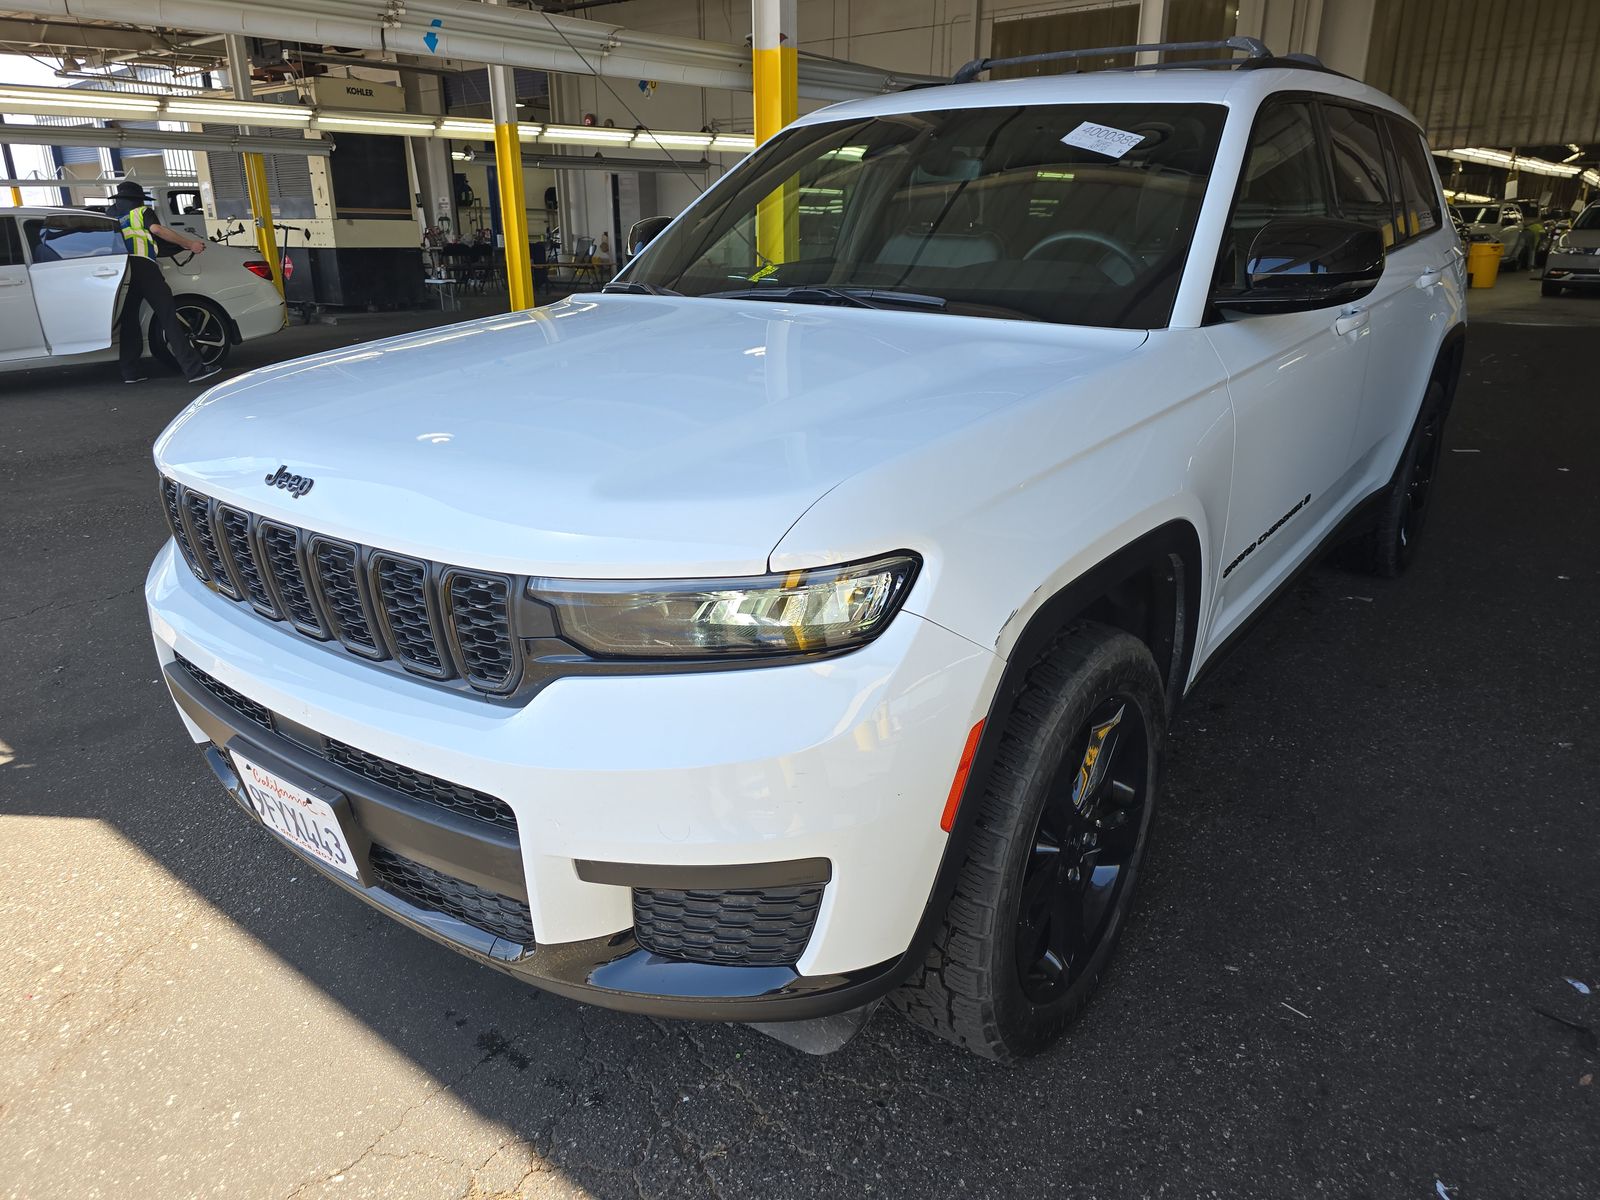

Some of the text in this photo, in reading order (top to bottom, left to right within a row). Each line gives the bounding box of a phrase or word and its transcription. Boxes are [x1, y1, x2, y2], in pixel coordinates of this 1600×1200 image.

[346, 87, 374, 97] KOHLER
[1083, 127, 1141, 147] 4000386
[265, 464, 314, 499] Jeep
[252, 768, 315, 812] California
[249, 784, 347, 864] 9FYX443
